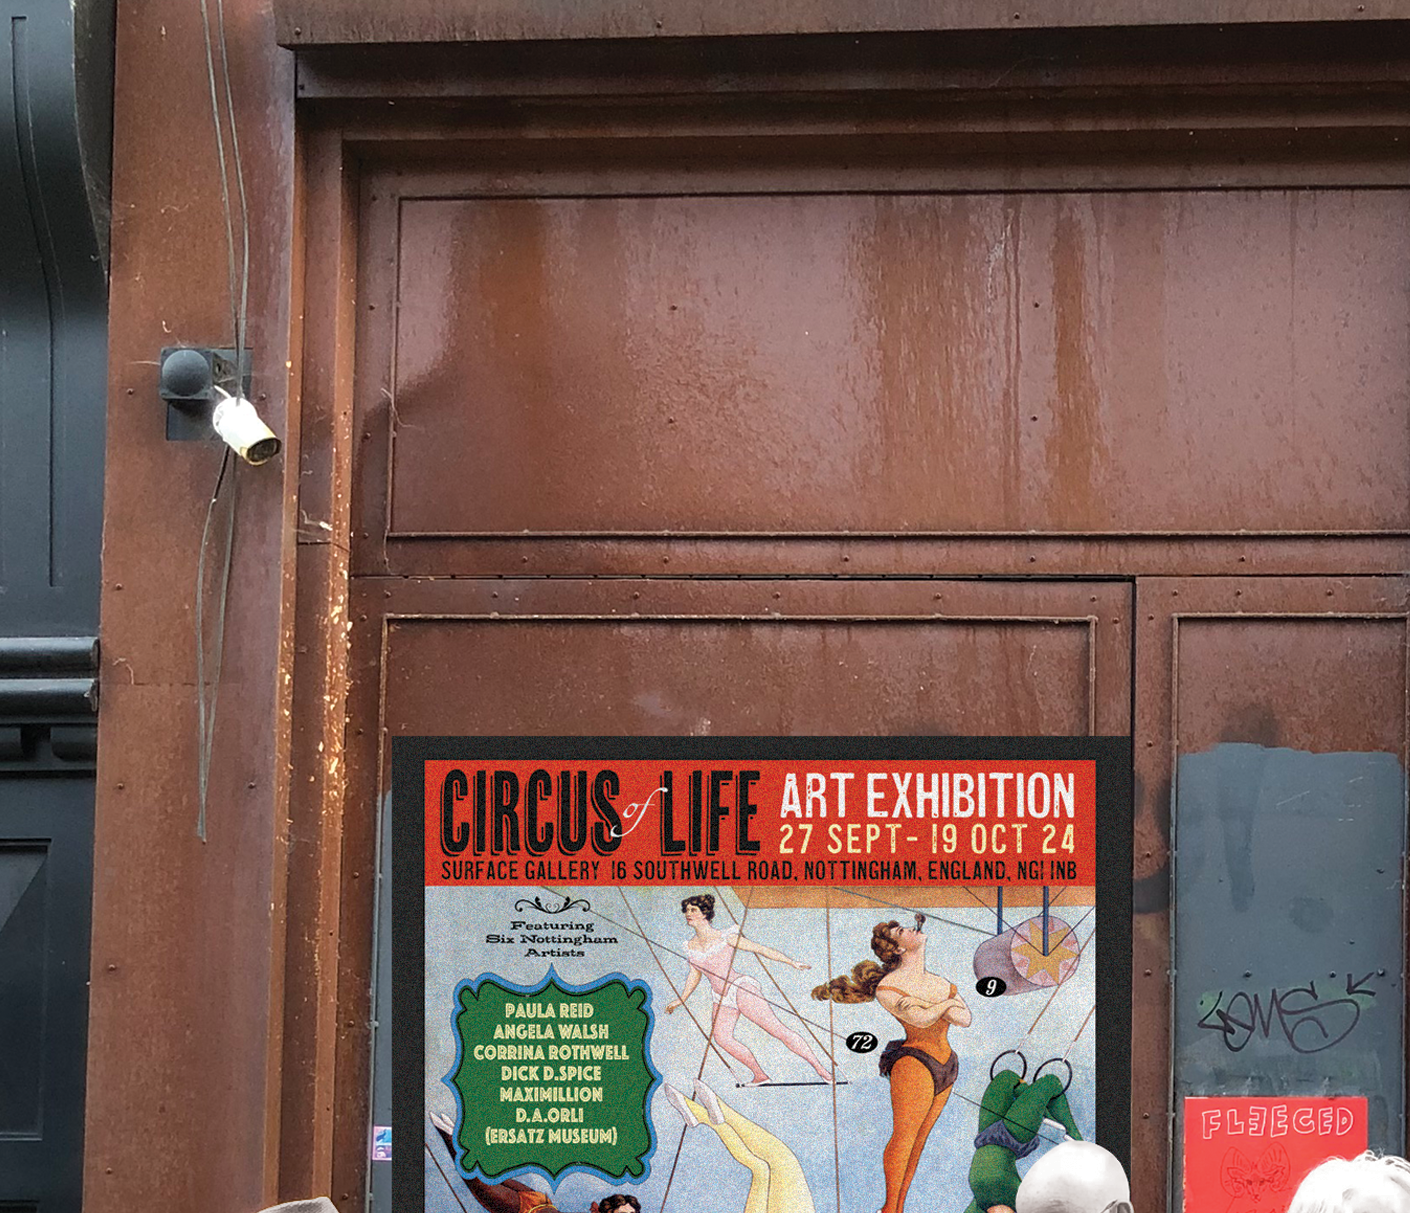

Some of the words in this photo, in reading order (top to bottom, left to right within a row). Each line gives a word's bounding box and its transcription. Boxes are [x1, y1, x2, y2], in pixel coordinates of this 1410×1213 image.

[780, 772, 855, 818] ART
[866, 772, 1075, 818] EXHIBITION
[440, 769, 623, 857] CIRCUS
[610, 787, 668, 838] of
[659, 770, 761, 857] LIFE
[779, 823, 813, 854] 27
[932, 823, 957, 854] 19
[971, 823, 1028, 854] OCT
[1042, 823, 1075, 854] 24
[441, 861, 519, 880] SURFACE
[525, 861, 600, 880] GALLERY
[611, 861, 627, 880] 16
[633, 861, 741, 880] SOUTHWELL
[749, 861, 798, 882] ROAD,
[804, 861, 922, 882] NOTTINGHAM,
[928, 861, 1011, 882] ENGLAND,
[510, 921, 595, 932] Featuring
[485, 934, 515, 944] Six
[520, 934, 618, 945] Nottingham
[524, 948, 585, 958] Artists
[985, 979, 998, 996] 9
[505, 1003, 555, 1018] PAULA
[560, 1003, 594, 1018] REID
[493, 1024, 555, 1039] ANGELA
[558, 1024, 609, 1039] WALSH
[851, 1034, 874, 1050] 72
[473, 1045, 545, 1060] CORRINA
[549, 1045, 629, 1060] ROTHWELL
[501, 1066, 540, 1081] DICK
[543, 1066, 602, 1081] D.SPICE
[500, 1087, 603, 1102] MAXIMILLION
[516, 1108, 584, 1123] D.A.ORLI
[1202, 1104, 1353, 1139] FLEECED
[485, 1126, 545, 1145] (ERSATZ
[549, 1126, 618, 1145] MUSEUM)
